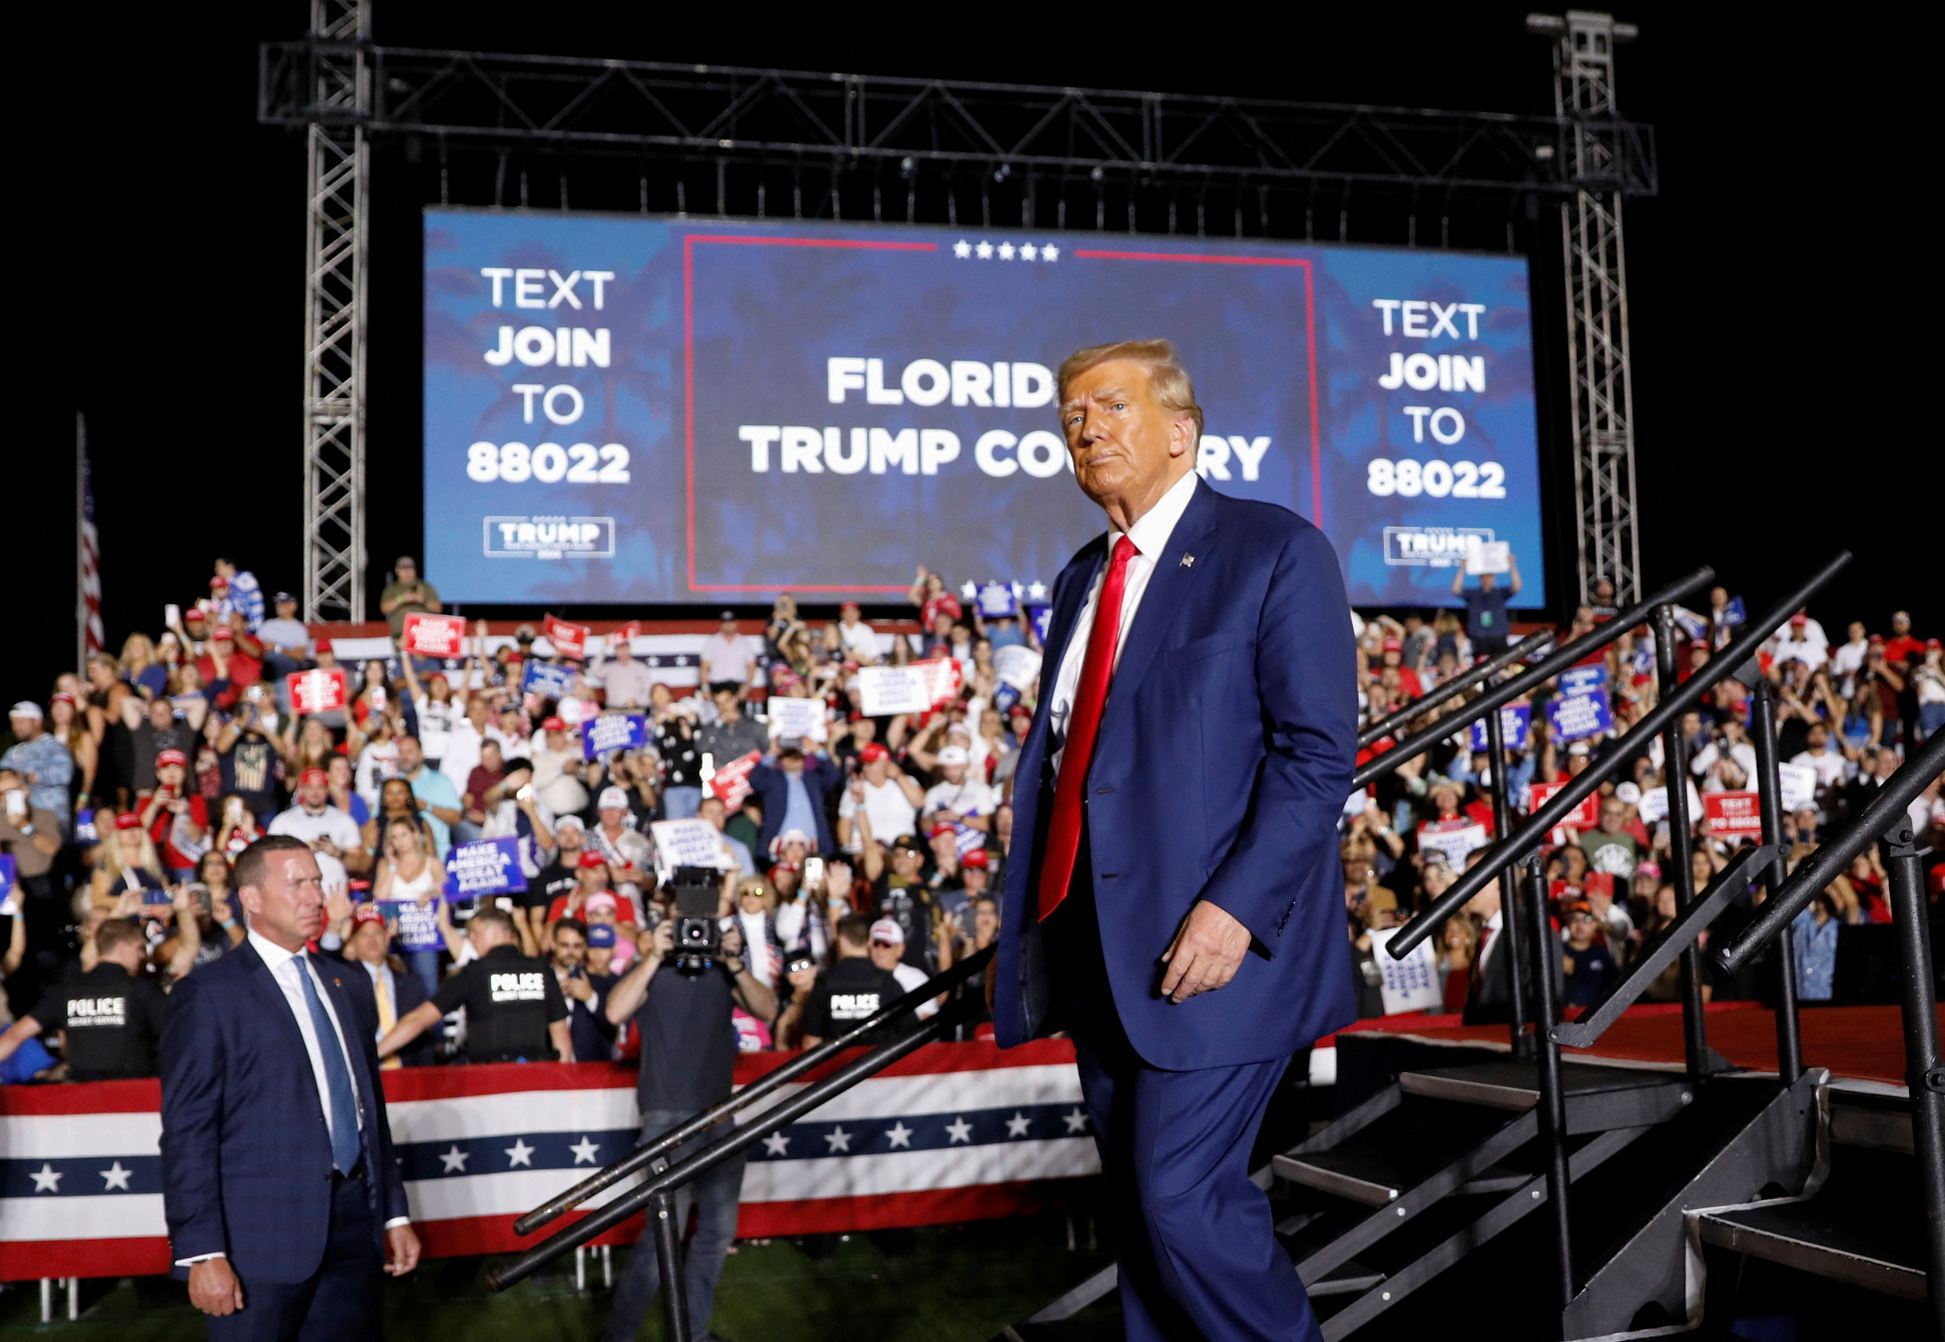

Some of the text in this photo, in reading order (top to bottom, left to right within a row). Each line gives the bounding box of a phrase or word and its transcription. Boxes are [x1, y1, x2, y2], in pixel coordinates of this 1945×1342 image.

[480, 267, 615, 310] TEXT
[1373, 299, 1485, 340] TEXT
[483, 325, 611, 368] JOIN
[827, 357, 1057, 408] FLORID
[1378, 352, 1486, 393] JOIN
[511, 383, 585, 426] TO
[1403, 406, 1465, 445] TO
[466, 441, 631, 484] 88022
[738, 425, 1272, 482] TRUMP CORY
[1367, 458, 1506, 499] 88022
[498, 523, 600, 544] TRUMP
[446, 852, 512, 873] AMERICA
[456, 842, 498, 859] MAKE
[456, 864, 505, 881] GREAT
[458, 875, 509, 893] AGAIN!
[490, 972, 544, 991] POLICE
[67, 997, 126, 1017] POLICE
[830, 994, 880, 1010] POLICE
